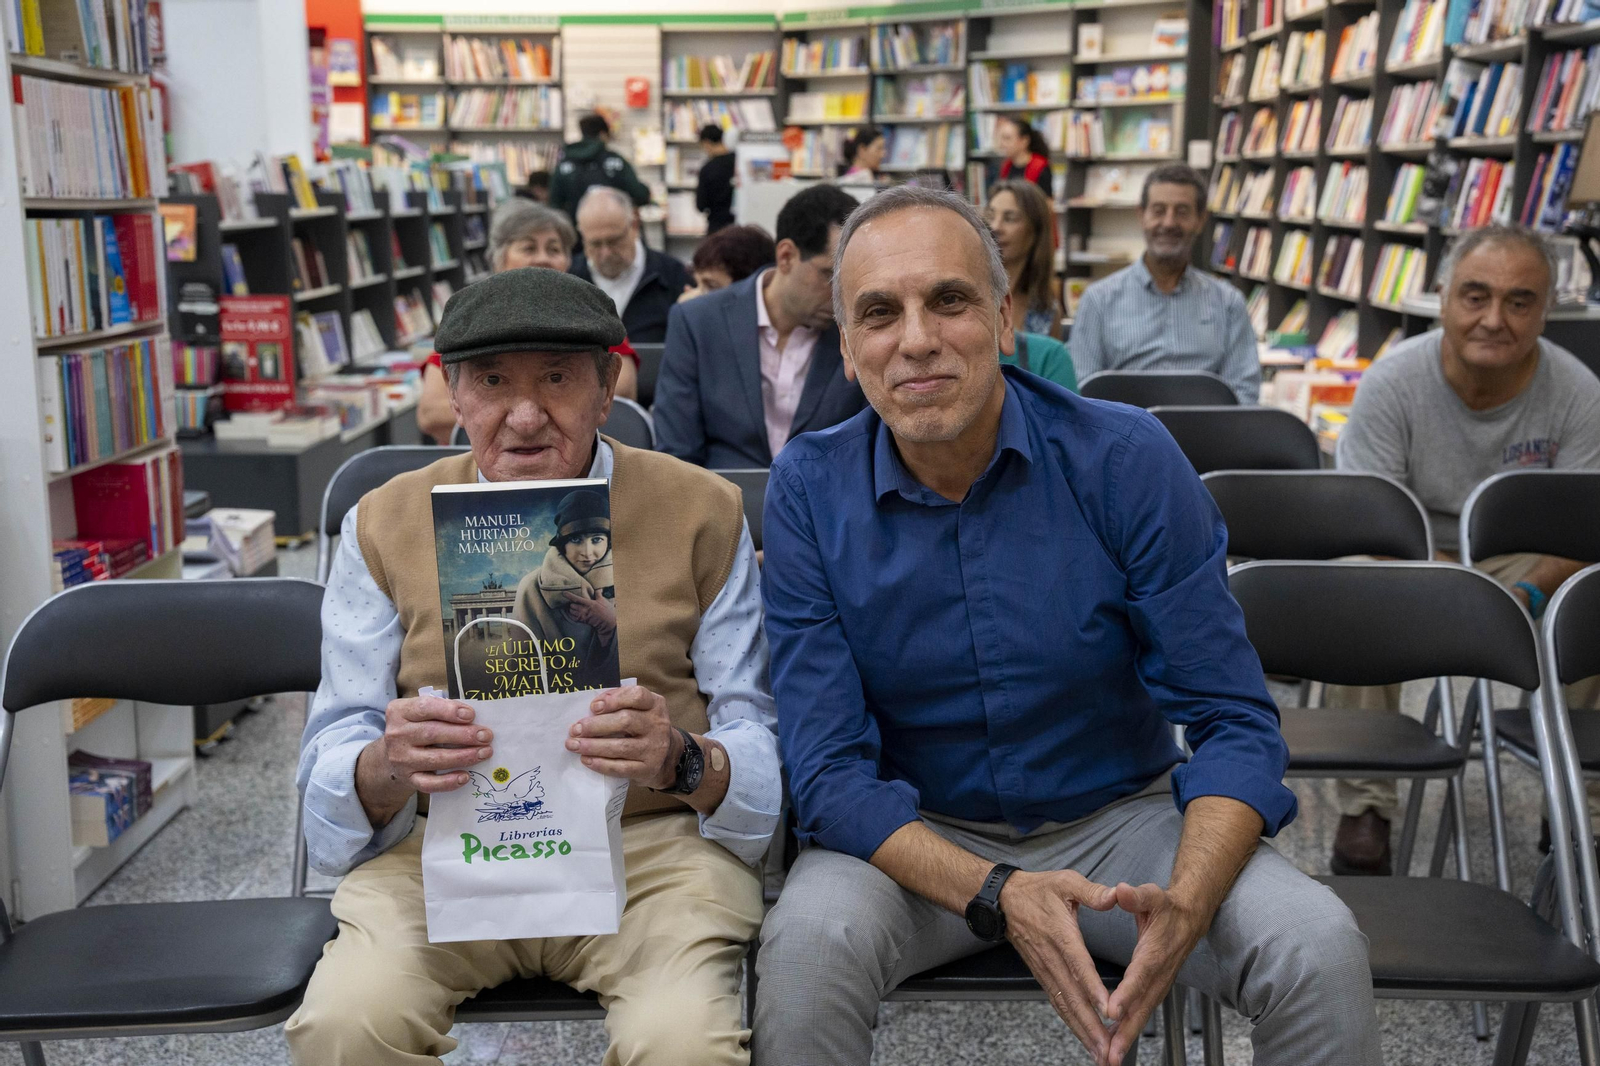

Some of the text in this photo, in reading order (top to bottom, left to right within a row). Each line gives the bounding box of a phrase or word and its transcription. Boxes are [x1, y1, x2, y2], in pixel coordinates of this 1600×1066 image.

[465, 514, 524, 528] MANUEL
[461, 526, 530, 541] HURTADO
[458, 540, 535, 556] MARJALIZO
[485, 655, 581, 674] SECRETO de
[493, 672, 574, 693] MATAS
[499, 827, 562, 841] Librerías
[460, 832, 572, 864] Picasso
